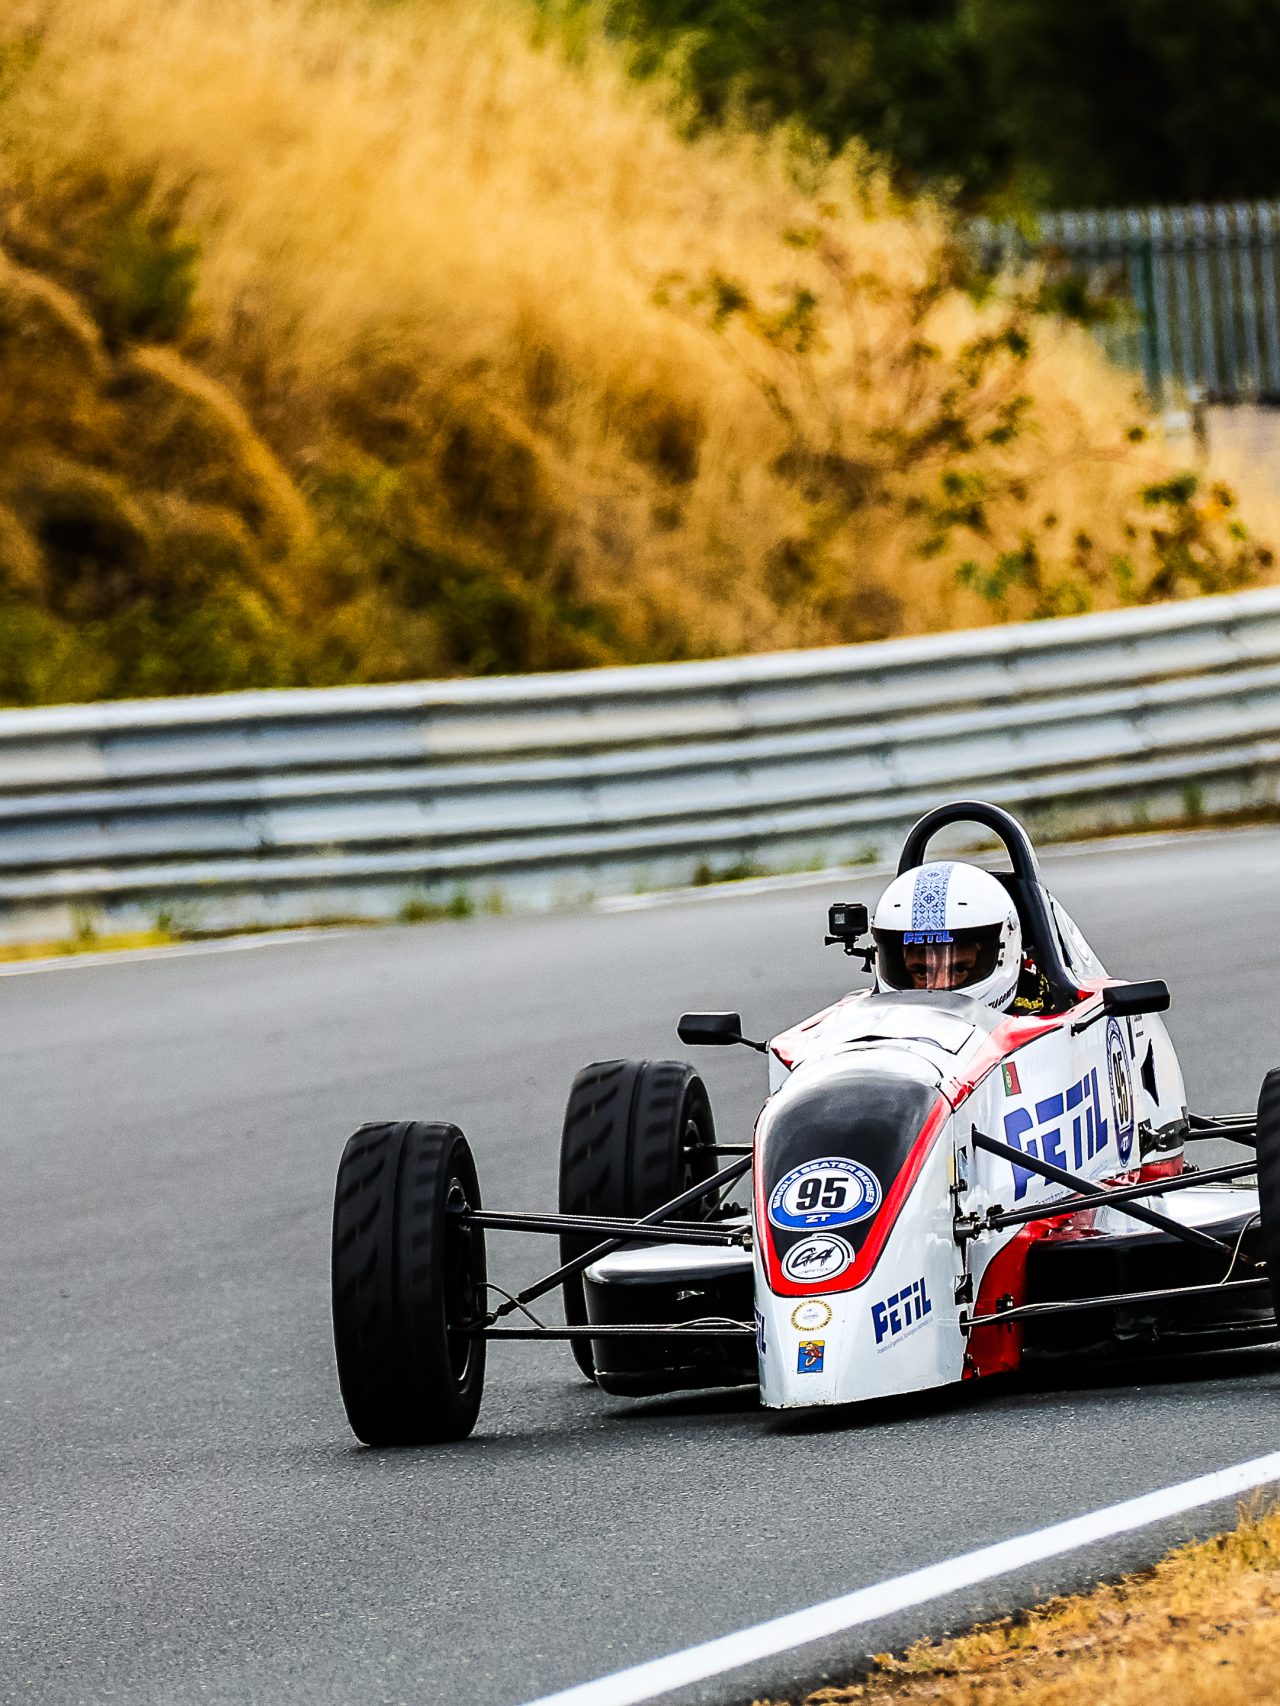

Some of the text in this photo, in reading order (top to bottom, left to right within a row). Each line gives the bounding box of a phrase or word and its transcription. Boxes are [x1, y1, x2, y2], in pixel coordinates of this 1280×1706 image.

[796, 1178, 849, 1211] 95
[854, 1170, 875, 1204] SERIES
[805, 1213, 831, 1223] ZT
